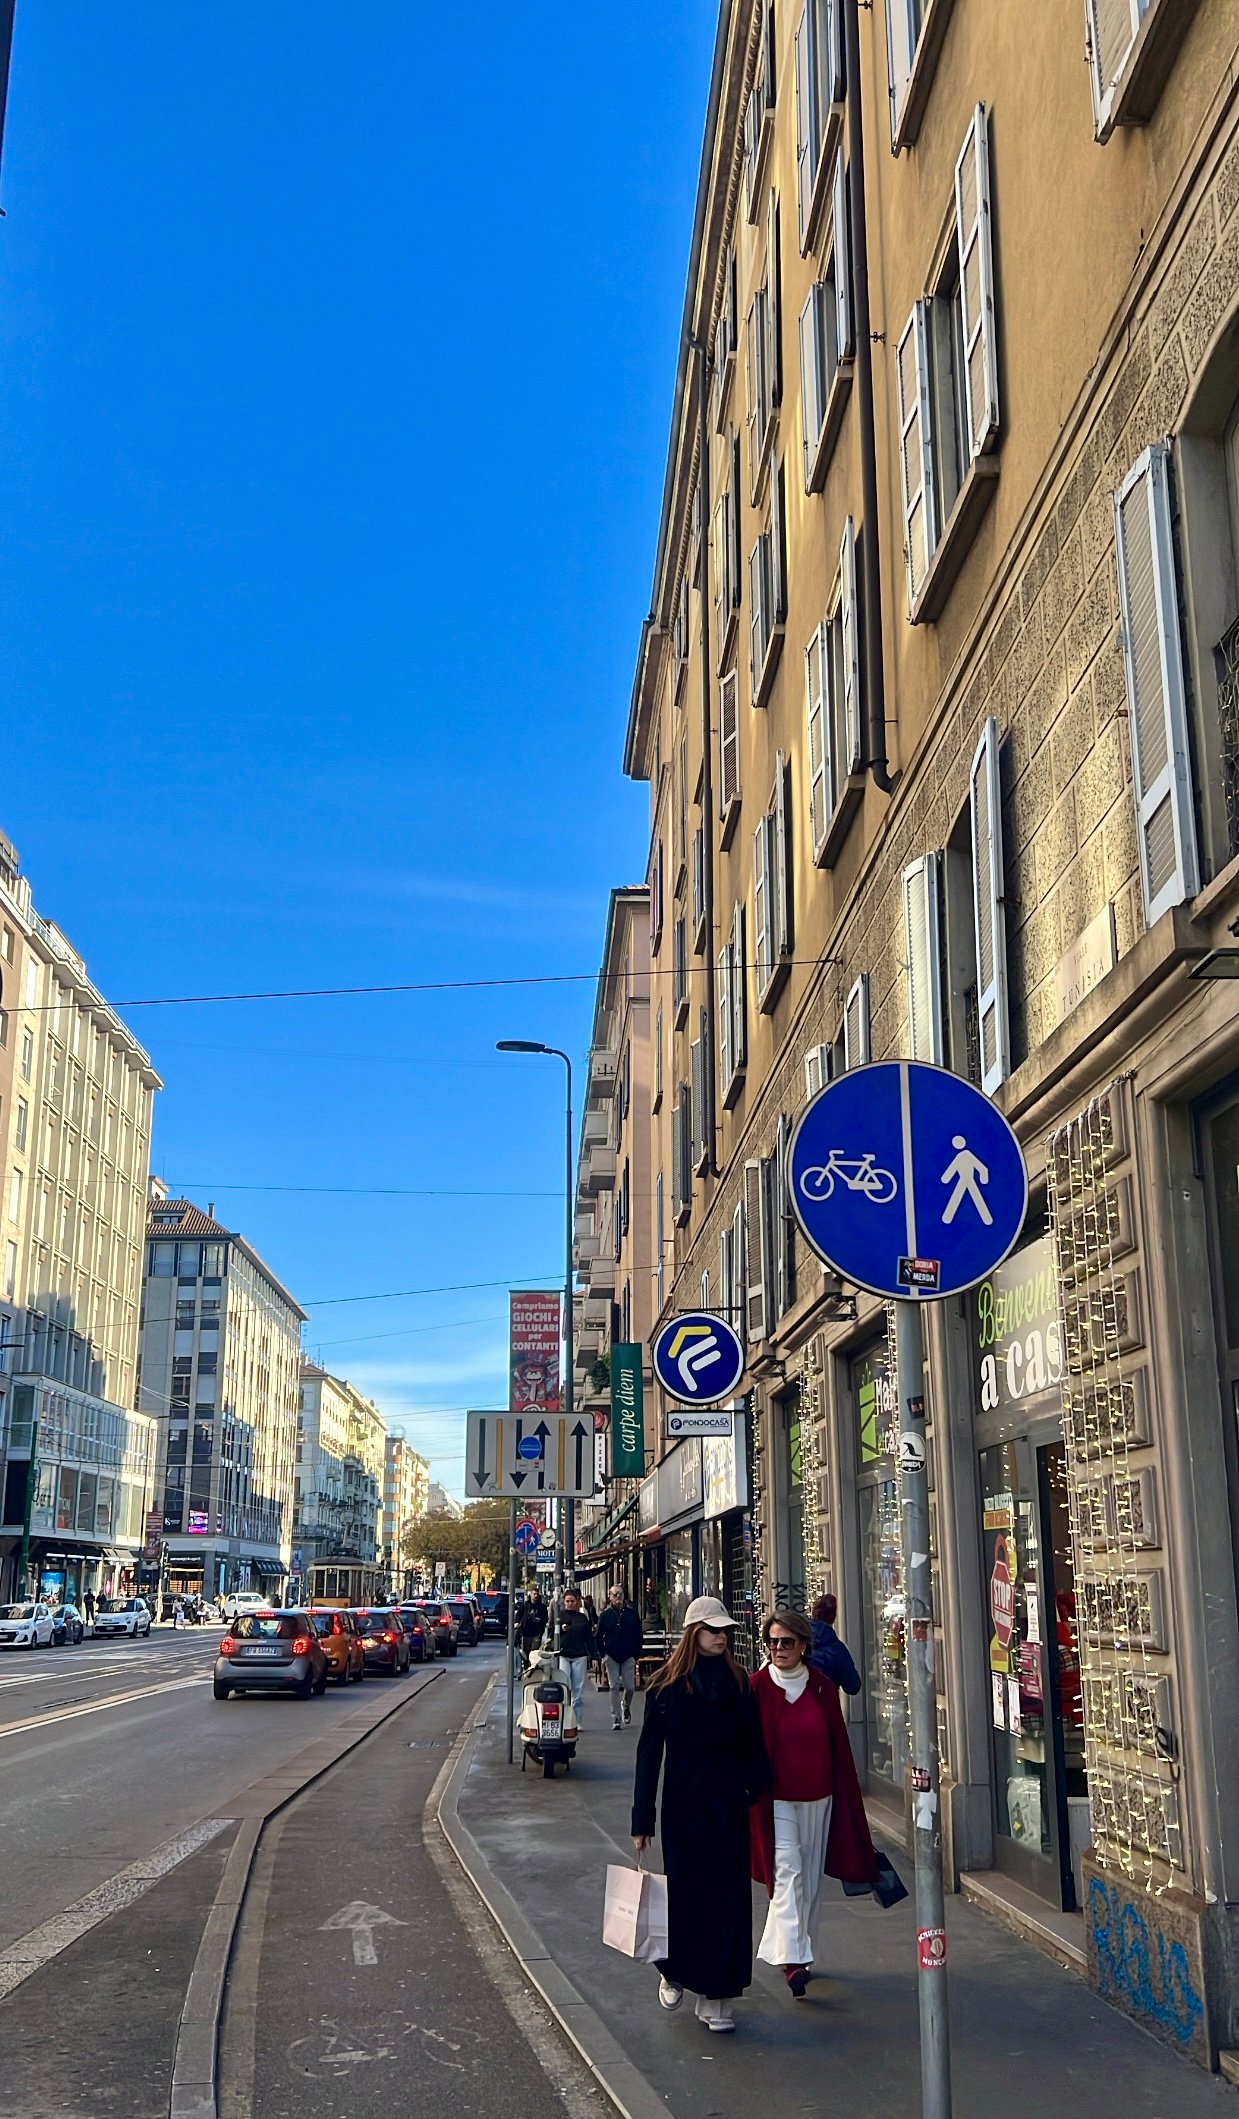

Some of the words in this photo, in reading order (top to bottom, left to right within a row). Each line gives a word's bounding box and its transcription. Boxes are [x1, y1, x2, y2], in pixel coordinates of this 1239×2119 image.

[1062, 957, 1104, 1013] TUNISIA
[512, 1302, 559, 1311] Compriamo
[512, 1312, 552, 1322] GIOCHI
[512, 1323, 559, 1332] CELLULARI
[528, 1333, 543, 1341] per
[512, 1342, 559, 1351] CONTANTI
[615, 1368, 635, 1406] diem
[980, 1354, 1000, 1412] a
[683, 1418, 729, 1427] FONDOCASA
[621, 1409, 641, 1452] carpe
[993, 1577, 1011, 1610] STOP
